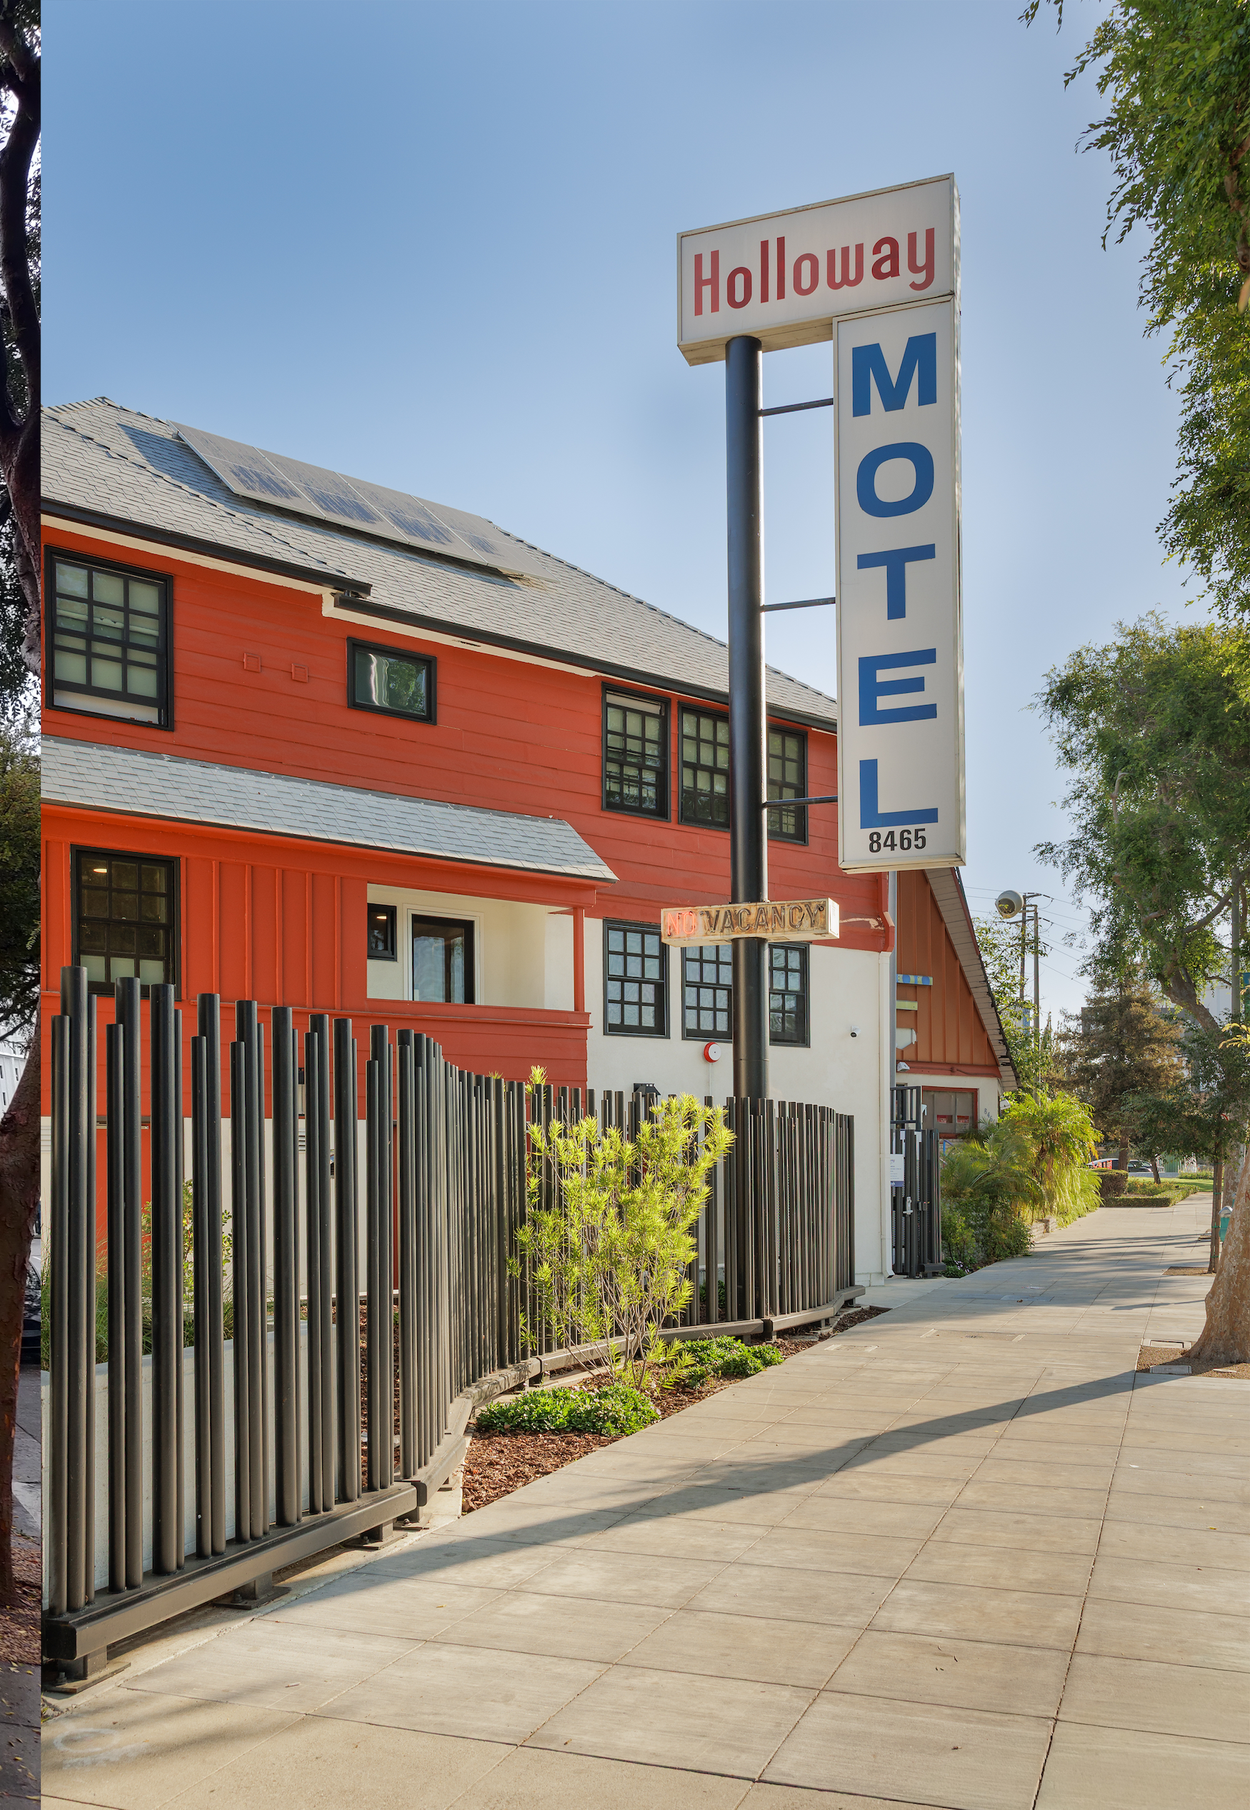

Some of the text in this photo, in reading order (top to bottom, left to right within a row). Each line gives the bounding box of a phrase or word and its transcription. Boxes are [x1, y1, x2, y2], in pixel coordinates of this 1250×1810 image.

[694, 227, 936, 317] Holloway
[851, 331, 939, 829] MOTEL
[868, 828, 927, 854] 8465
[666, 904, 824, 937] NO VACANCY
